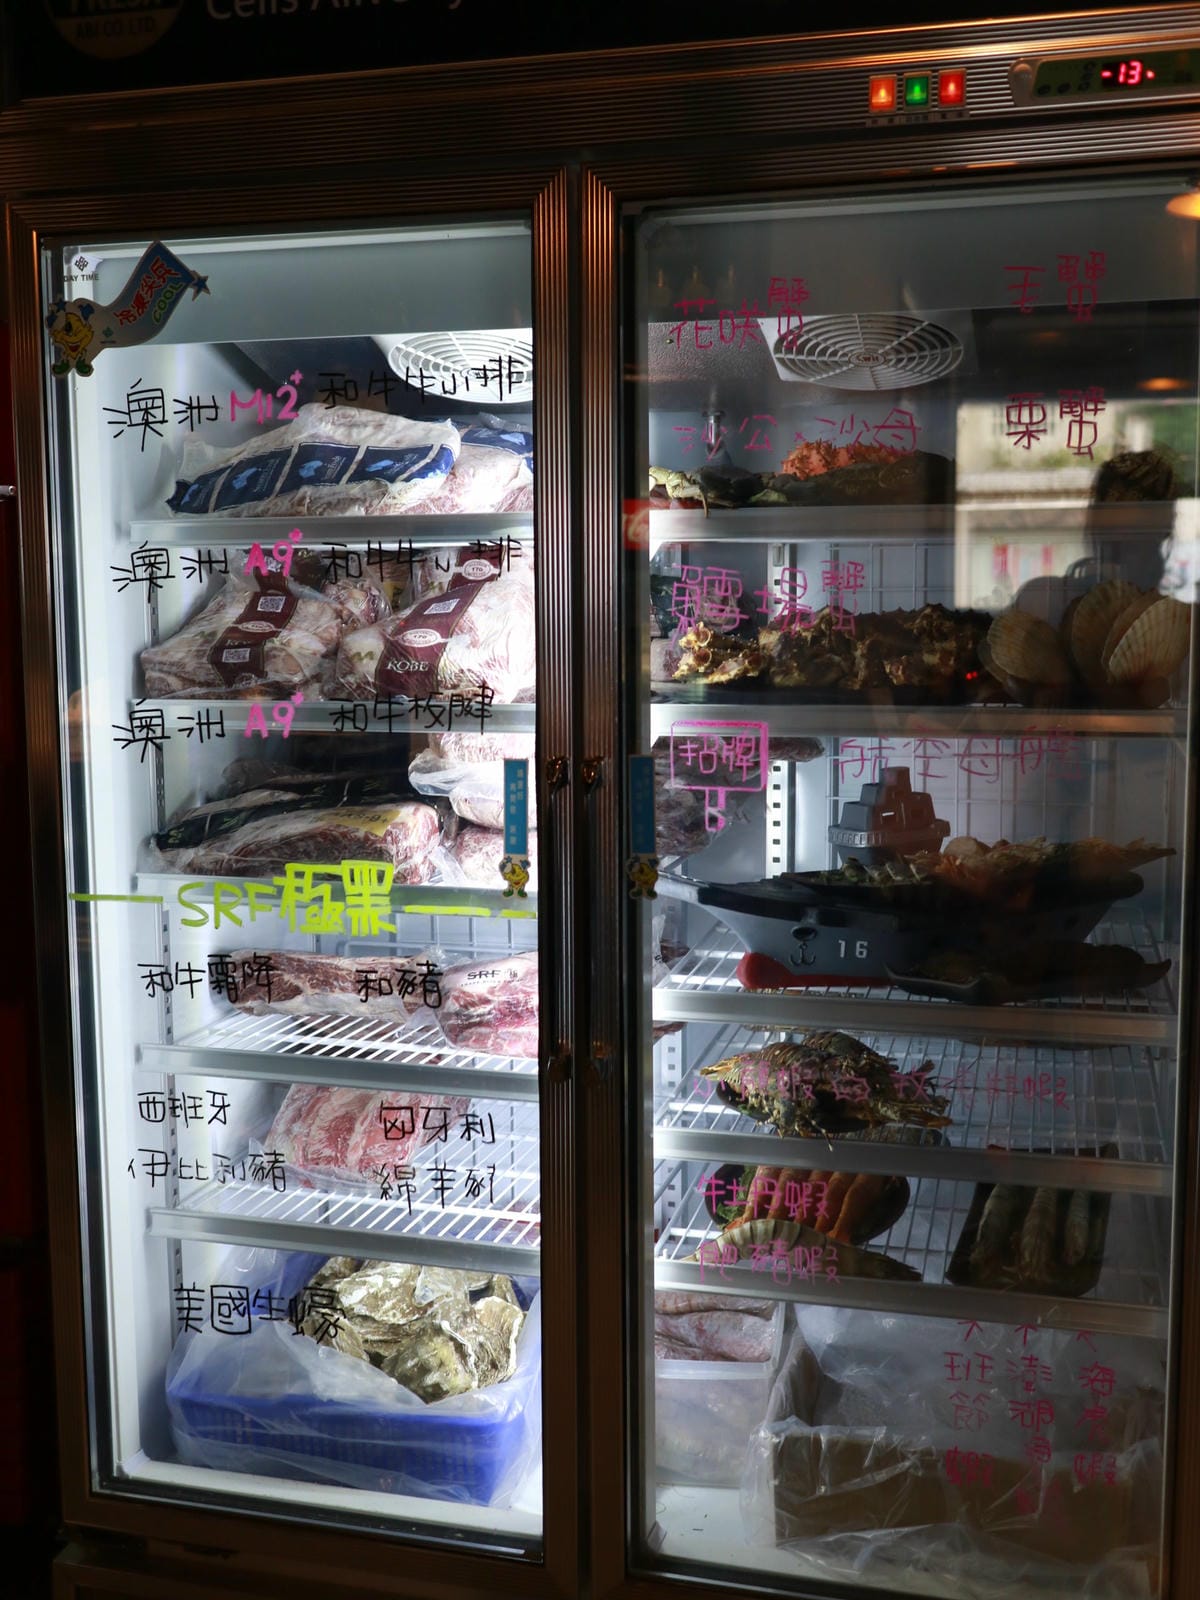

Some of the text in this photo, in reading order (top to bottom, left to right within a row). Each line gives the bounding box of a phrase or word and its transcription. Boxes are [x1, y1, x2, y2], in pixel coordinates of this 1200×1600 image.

[63, 273, 100, 283] DAY TIME
[152, 281, 184, 325] COOL
[103, 378, 220, 452] 澳洲
[318, 355, 524, 410] 和牛牛小排
[110, 540, 231, 603] 澳洲
[385, 659, 429, 674] KOBE
[112, 698, 226, 763] 澳洲
[678, 732, 756, 784] 招牌
[838, 939, 869, 959] 16
[137, 952, 276, 1004] 和牛霜降
[355, 960, 443, 1009] 和豬
[137, 1090, 231, 1129] 西班牙
[380, 1100, 496, 1145] 匈牙利
[127, 1148, 286, 1193] 伊比利豬
[696, 1173, 830, 1219] 牡丹蝦
[173, 1281, 347, 1344] 美國生蠔
